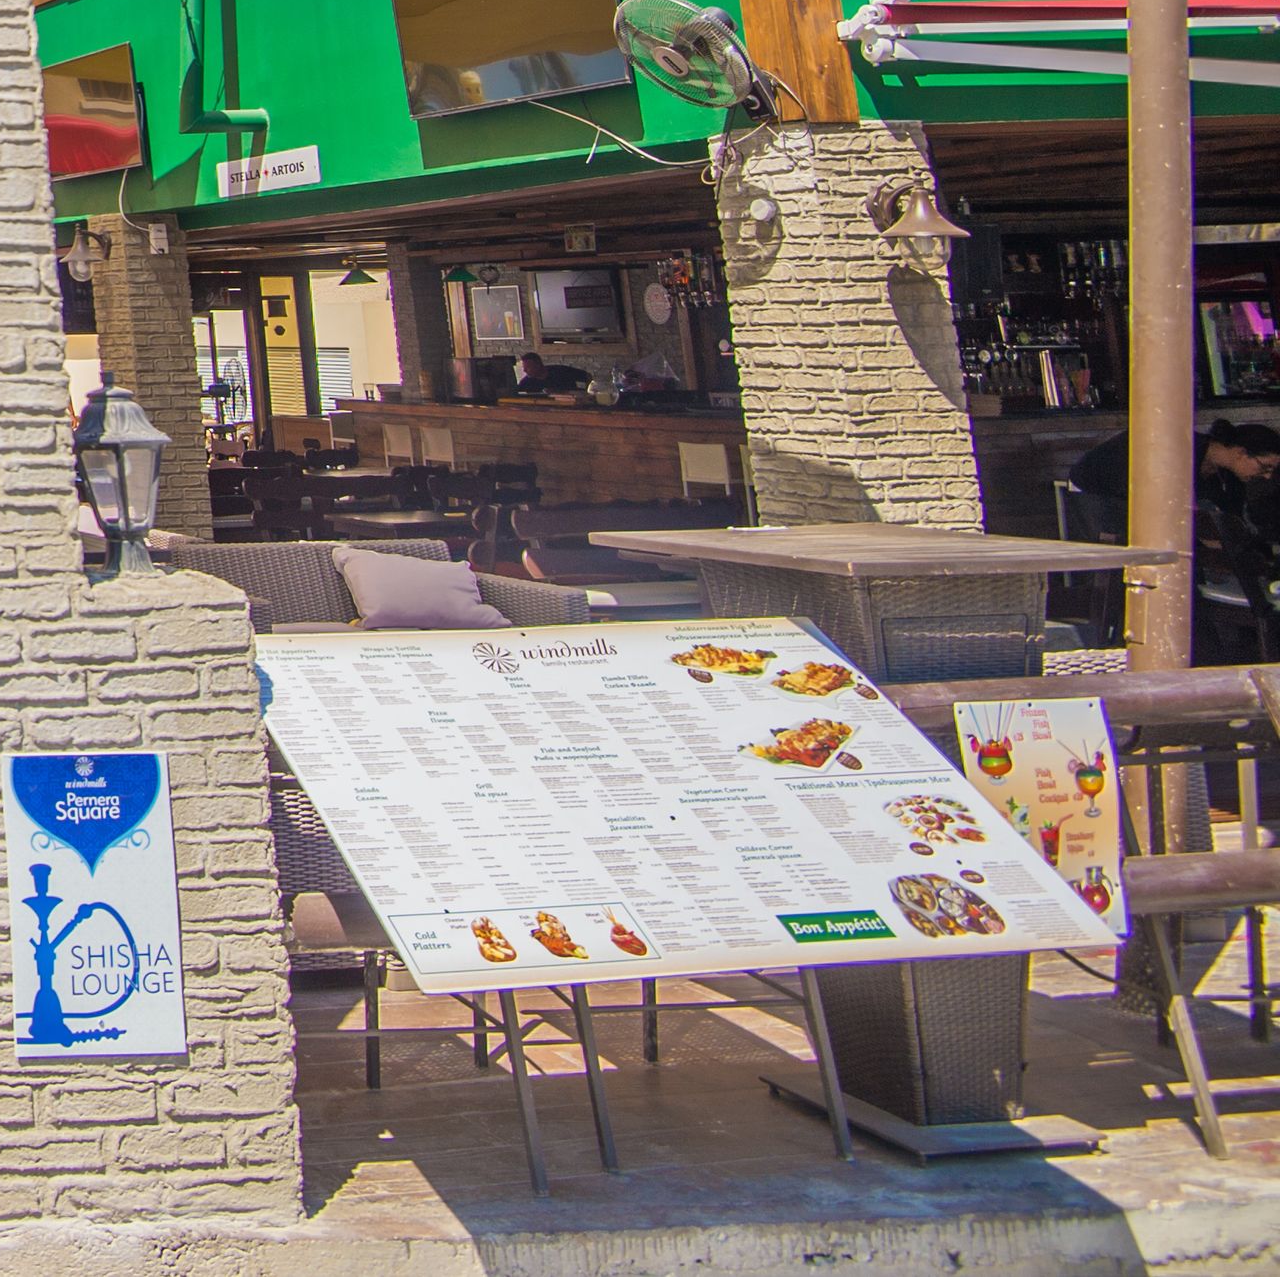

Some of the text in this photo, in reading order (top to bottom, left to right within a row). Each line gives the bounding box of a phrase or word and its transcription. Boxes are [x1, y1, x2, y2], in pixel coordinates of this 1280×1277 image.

[230, 161, 305, 184] STELLA ARTOIS
[520, 638, 618, 660] windmills
[541, 658, 609, 668] family restaurant
[1020, 708, 1048, 718] Frozen
[65, 777, 107, 789] windmills
[785, 781, 835, 792] Traditional
[66, 792, 120, 807] Pernera
[55, 800, 121, 825] Square
[789, 916, 887, 935] Bon Appétit!
[415, 931, 437, 940] Cold
[413, 941, 452, 951] Platters
[71, 943, 173, 970] SHISHA
[71, 971, 176, 997] LOUNGE
